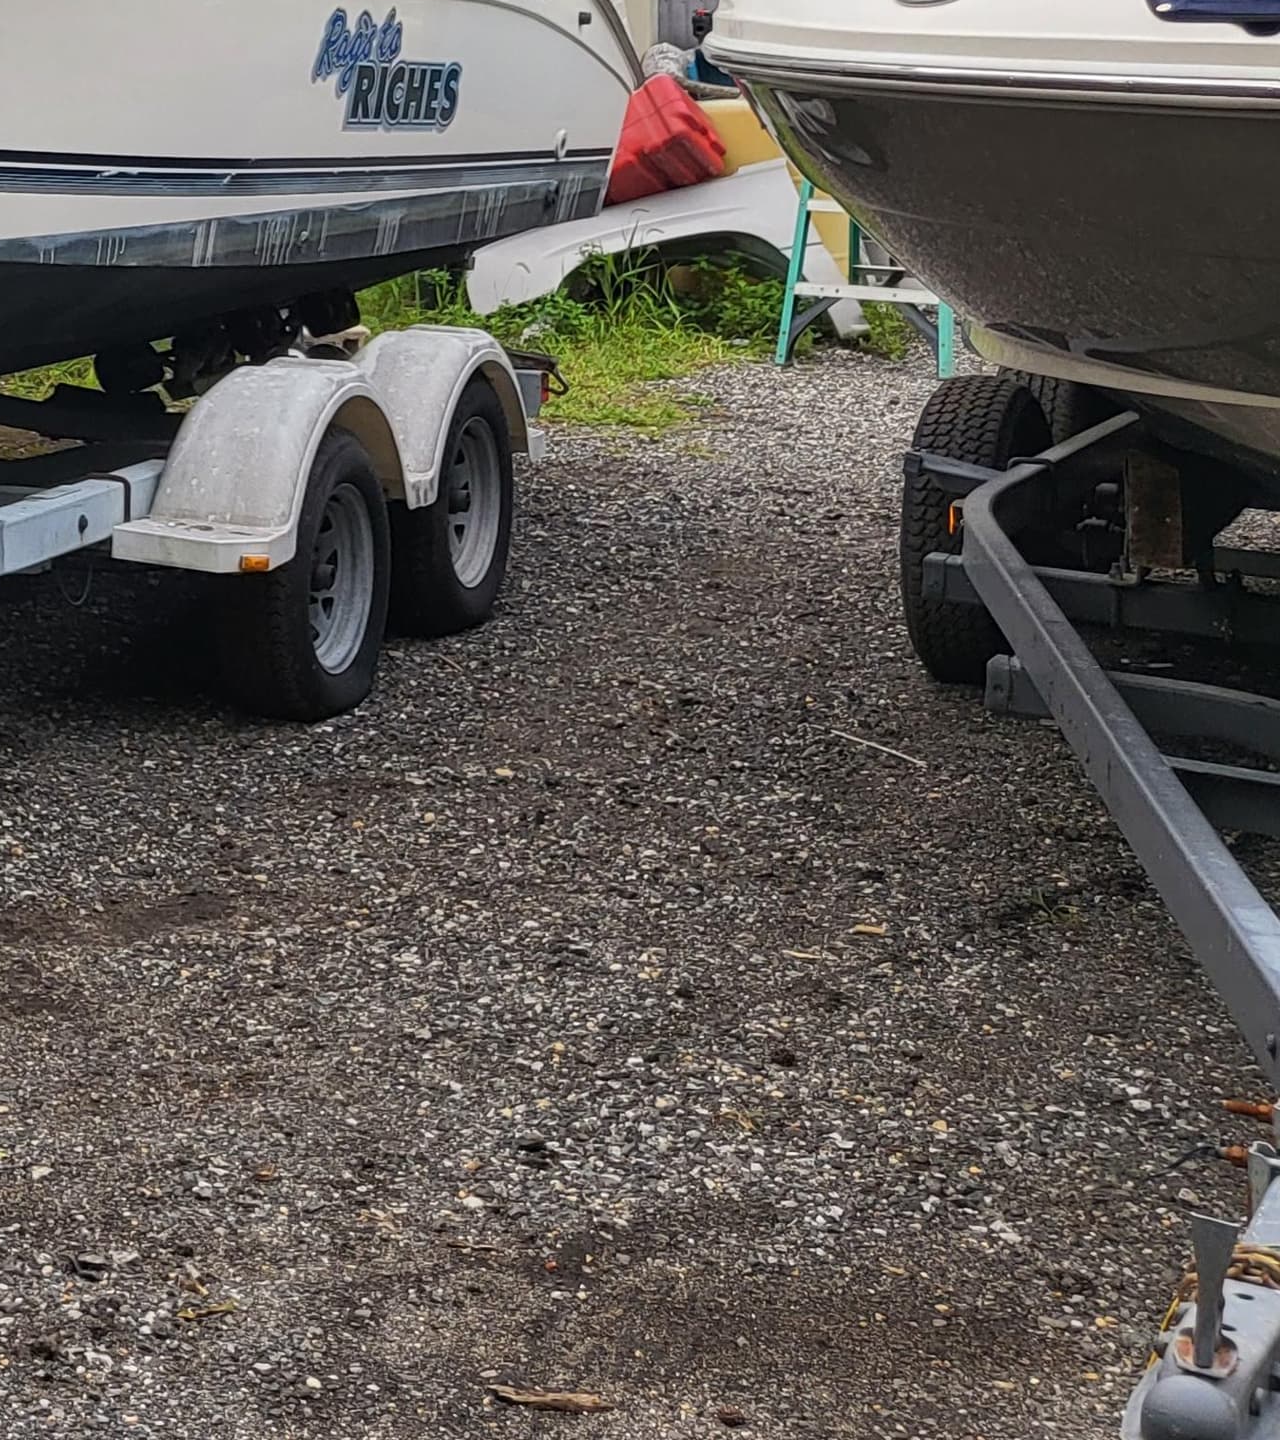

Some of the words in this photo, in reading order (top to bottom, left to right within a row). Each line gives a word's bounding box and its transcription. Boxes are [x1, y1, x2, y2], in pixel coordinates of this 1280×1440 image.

[313, 7, 377, 95] Rags
[377, 6, 403, 62] to
[344, 61, 462, 129] RICHES
